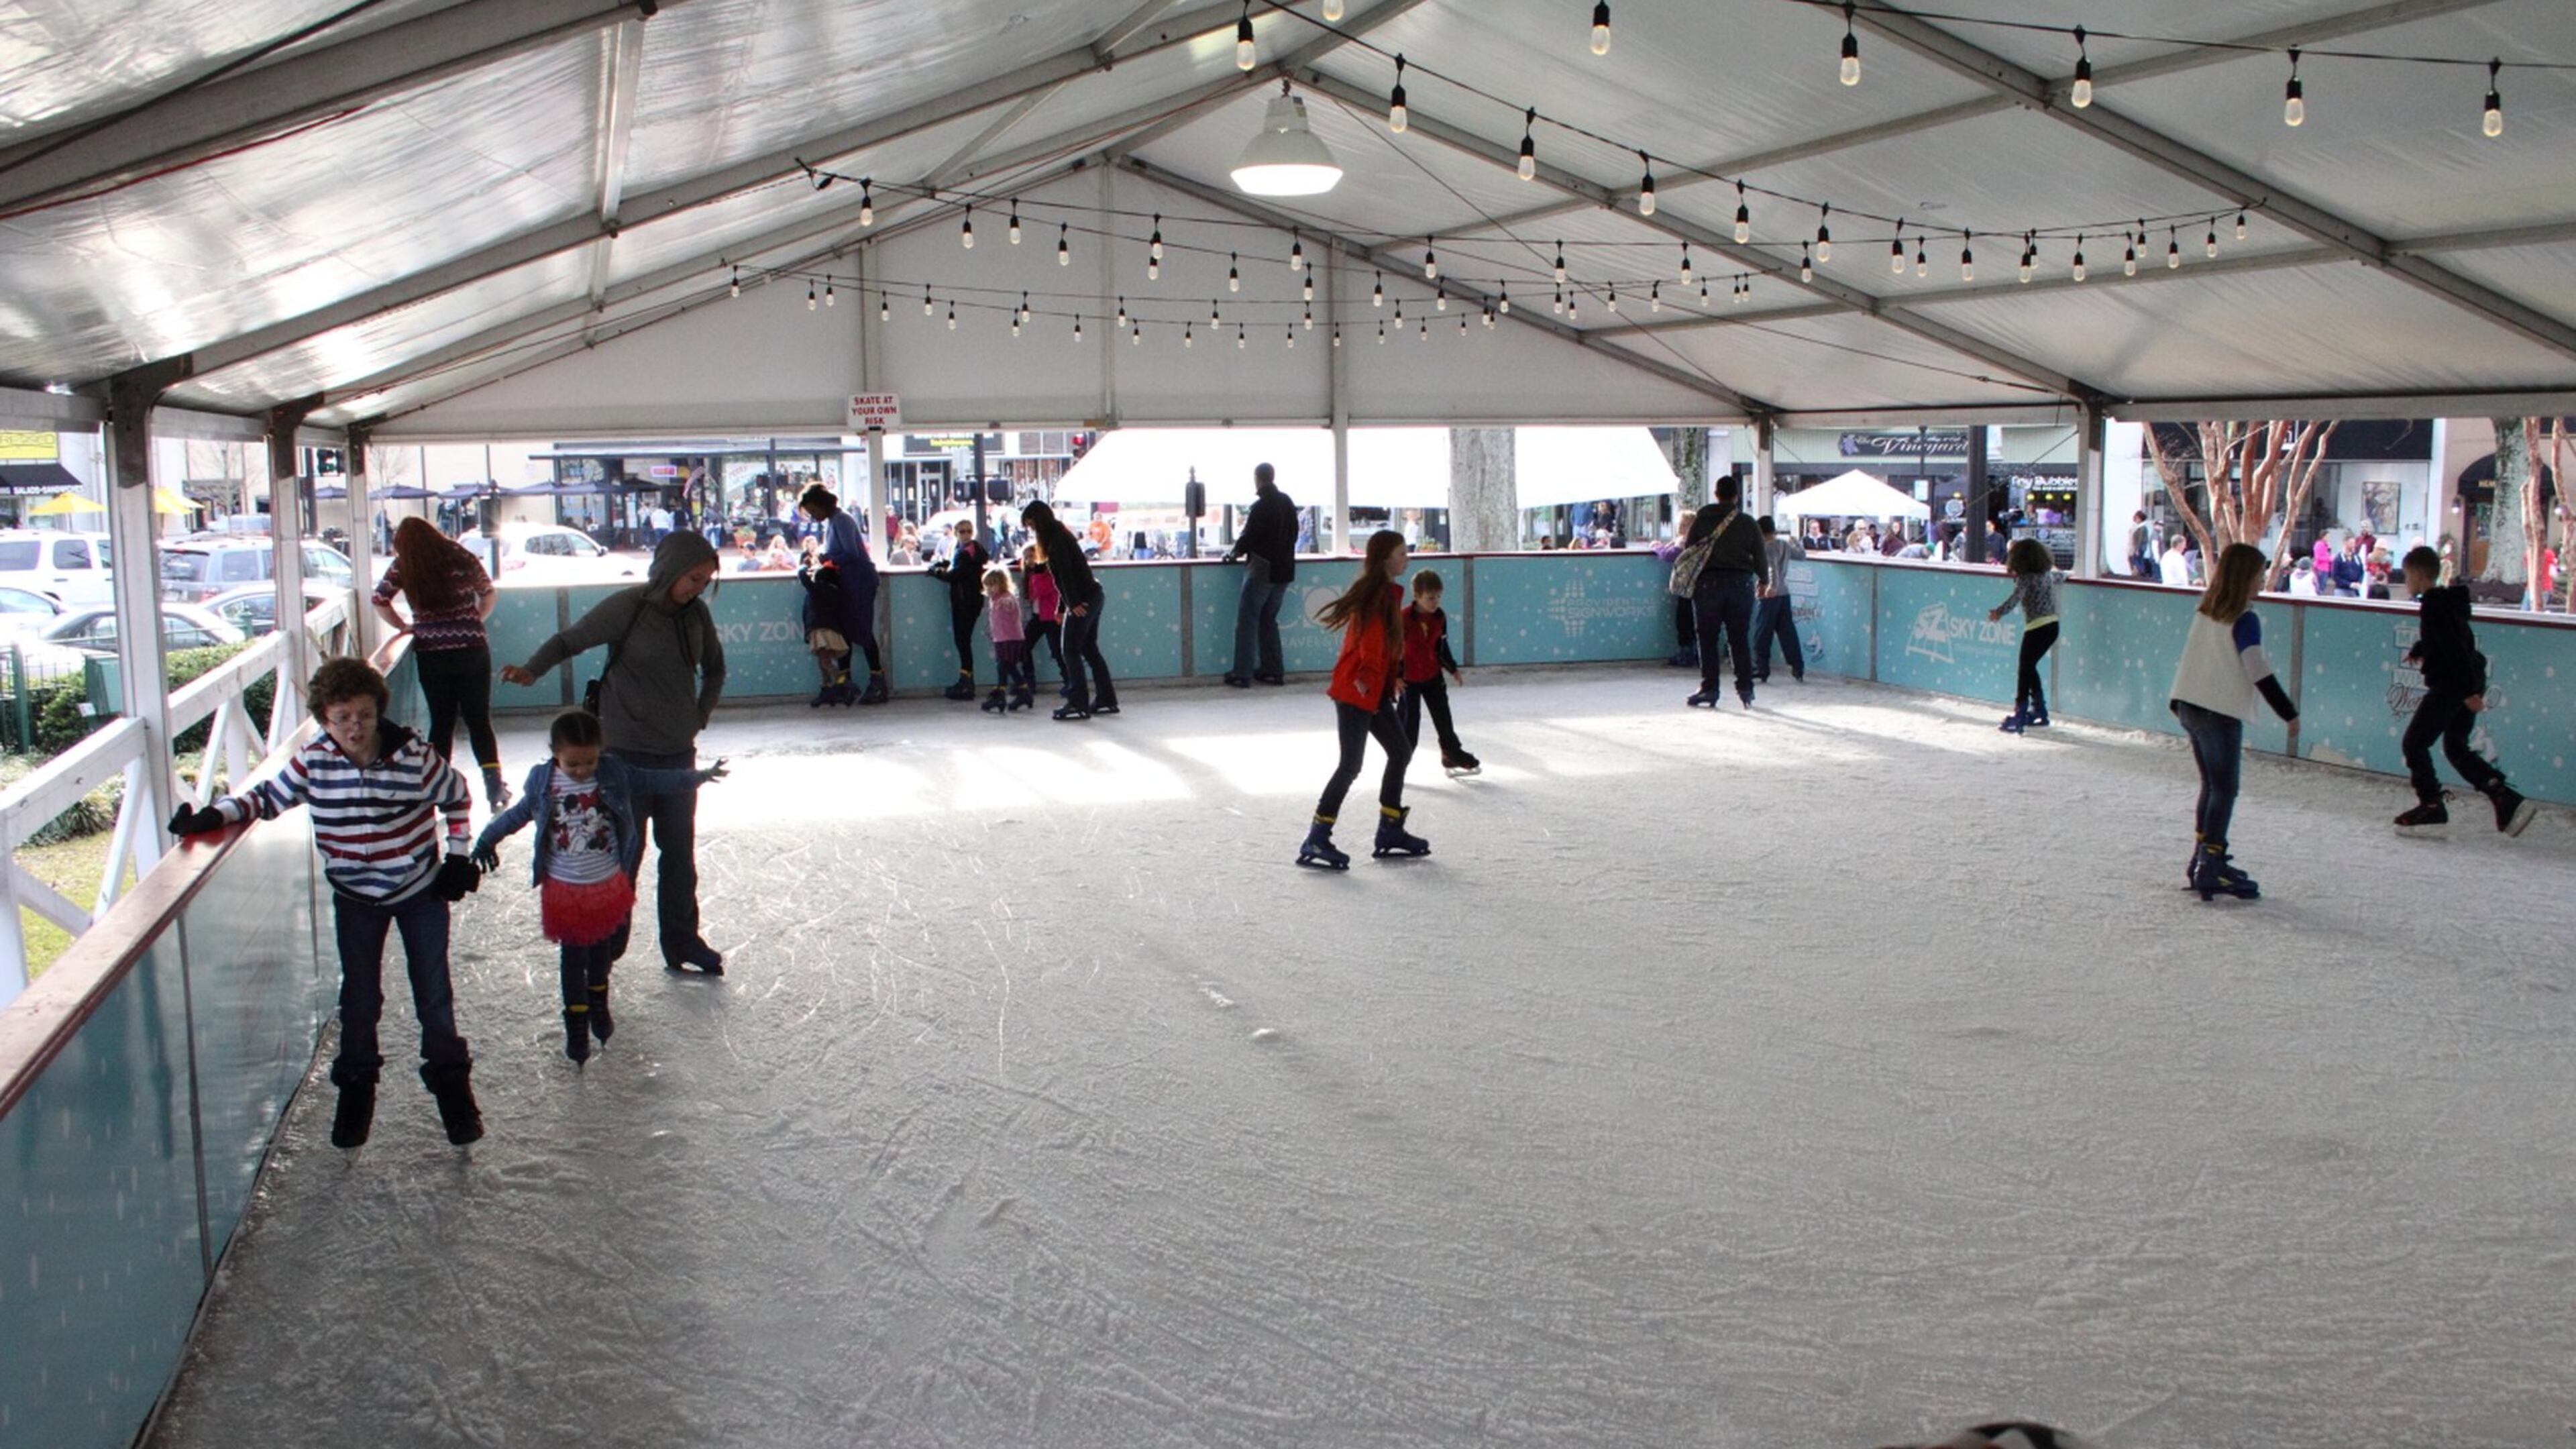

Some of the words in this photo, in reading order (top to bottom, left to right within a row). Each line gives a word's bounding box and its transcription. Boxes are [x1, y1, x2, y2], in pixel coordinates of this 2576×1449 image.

[854, 396, 881, 406] SKATE
[883, 396, 893, 404] AT
[851, 407, 875, 416] YOUR
[877, 406, 897, 415] OWN
[865, 417, 885, 425] RISK
[1870, 436, 1970, 455] Vineyard
[759, 621, 805, 641] ZON
[1949, 616, 1976, 639] SKY
[1978, 622, 2017, 646] ZONE
